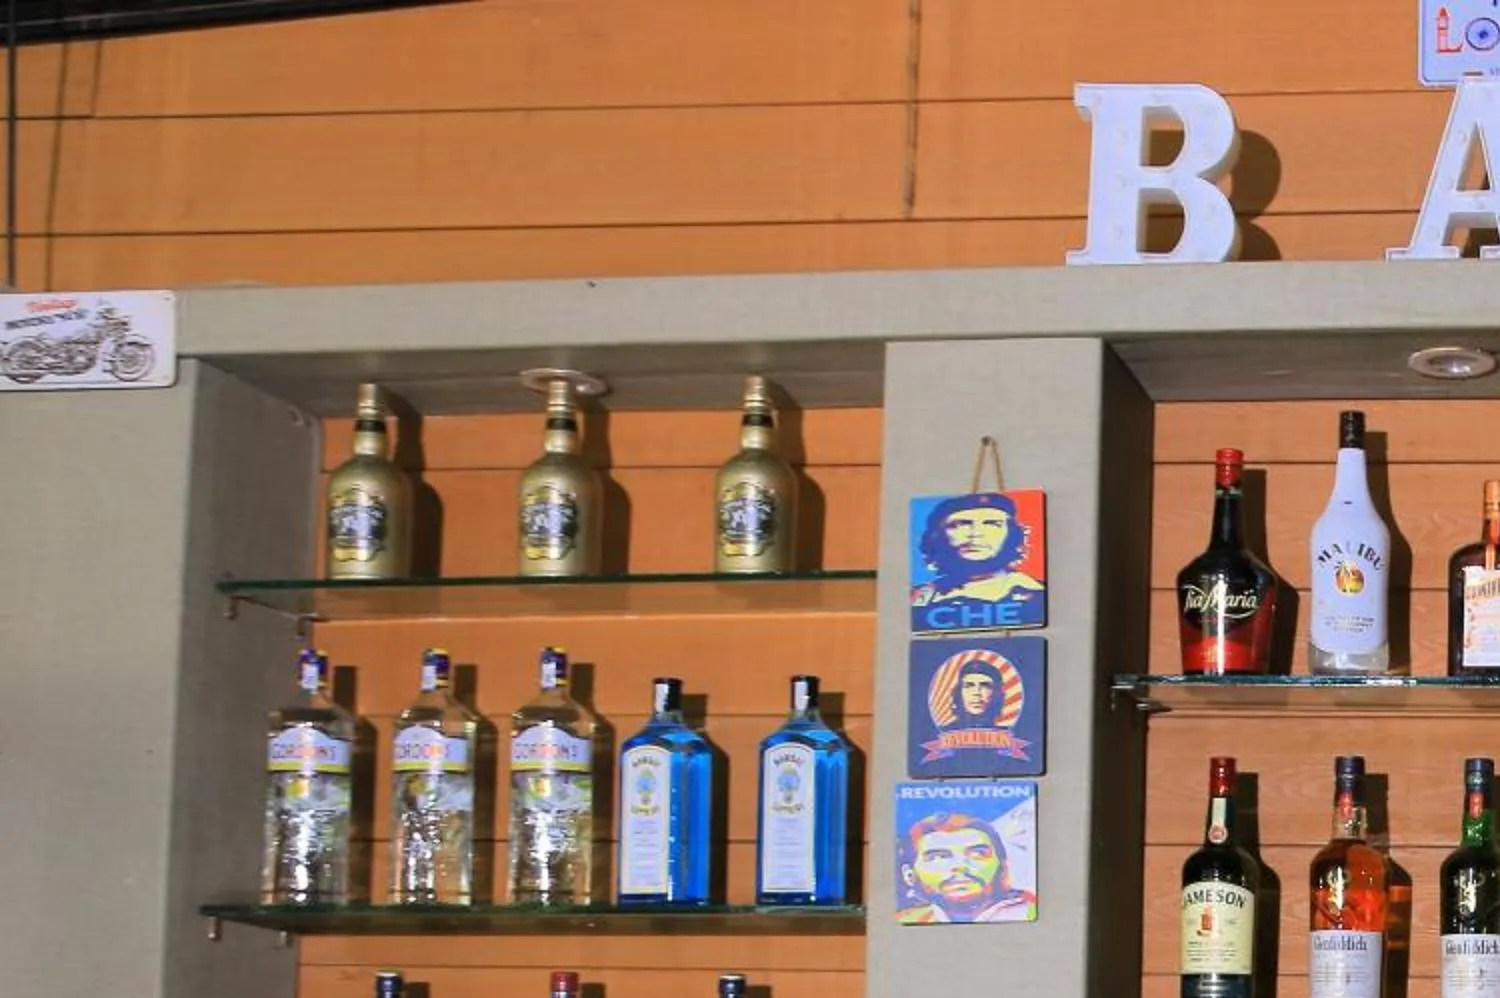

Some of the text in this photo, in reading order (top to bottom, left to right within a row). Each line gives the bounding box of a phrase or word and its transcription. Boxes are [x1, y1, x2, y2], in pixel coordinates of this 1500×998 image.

[926, 602, 1023, 630] CHE
[900, 784, 1031, 800] REVOLUTION
[1183, 889, 1247, 909] JAMESON
